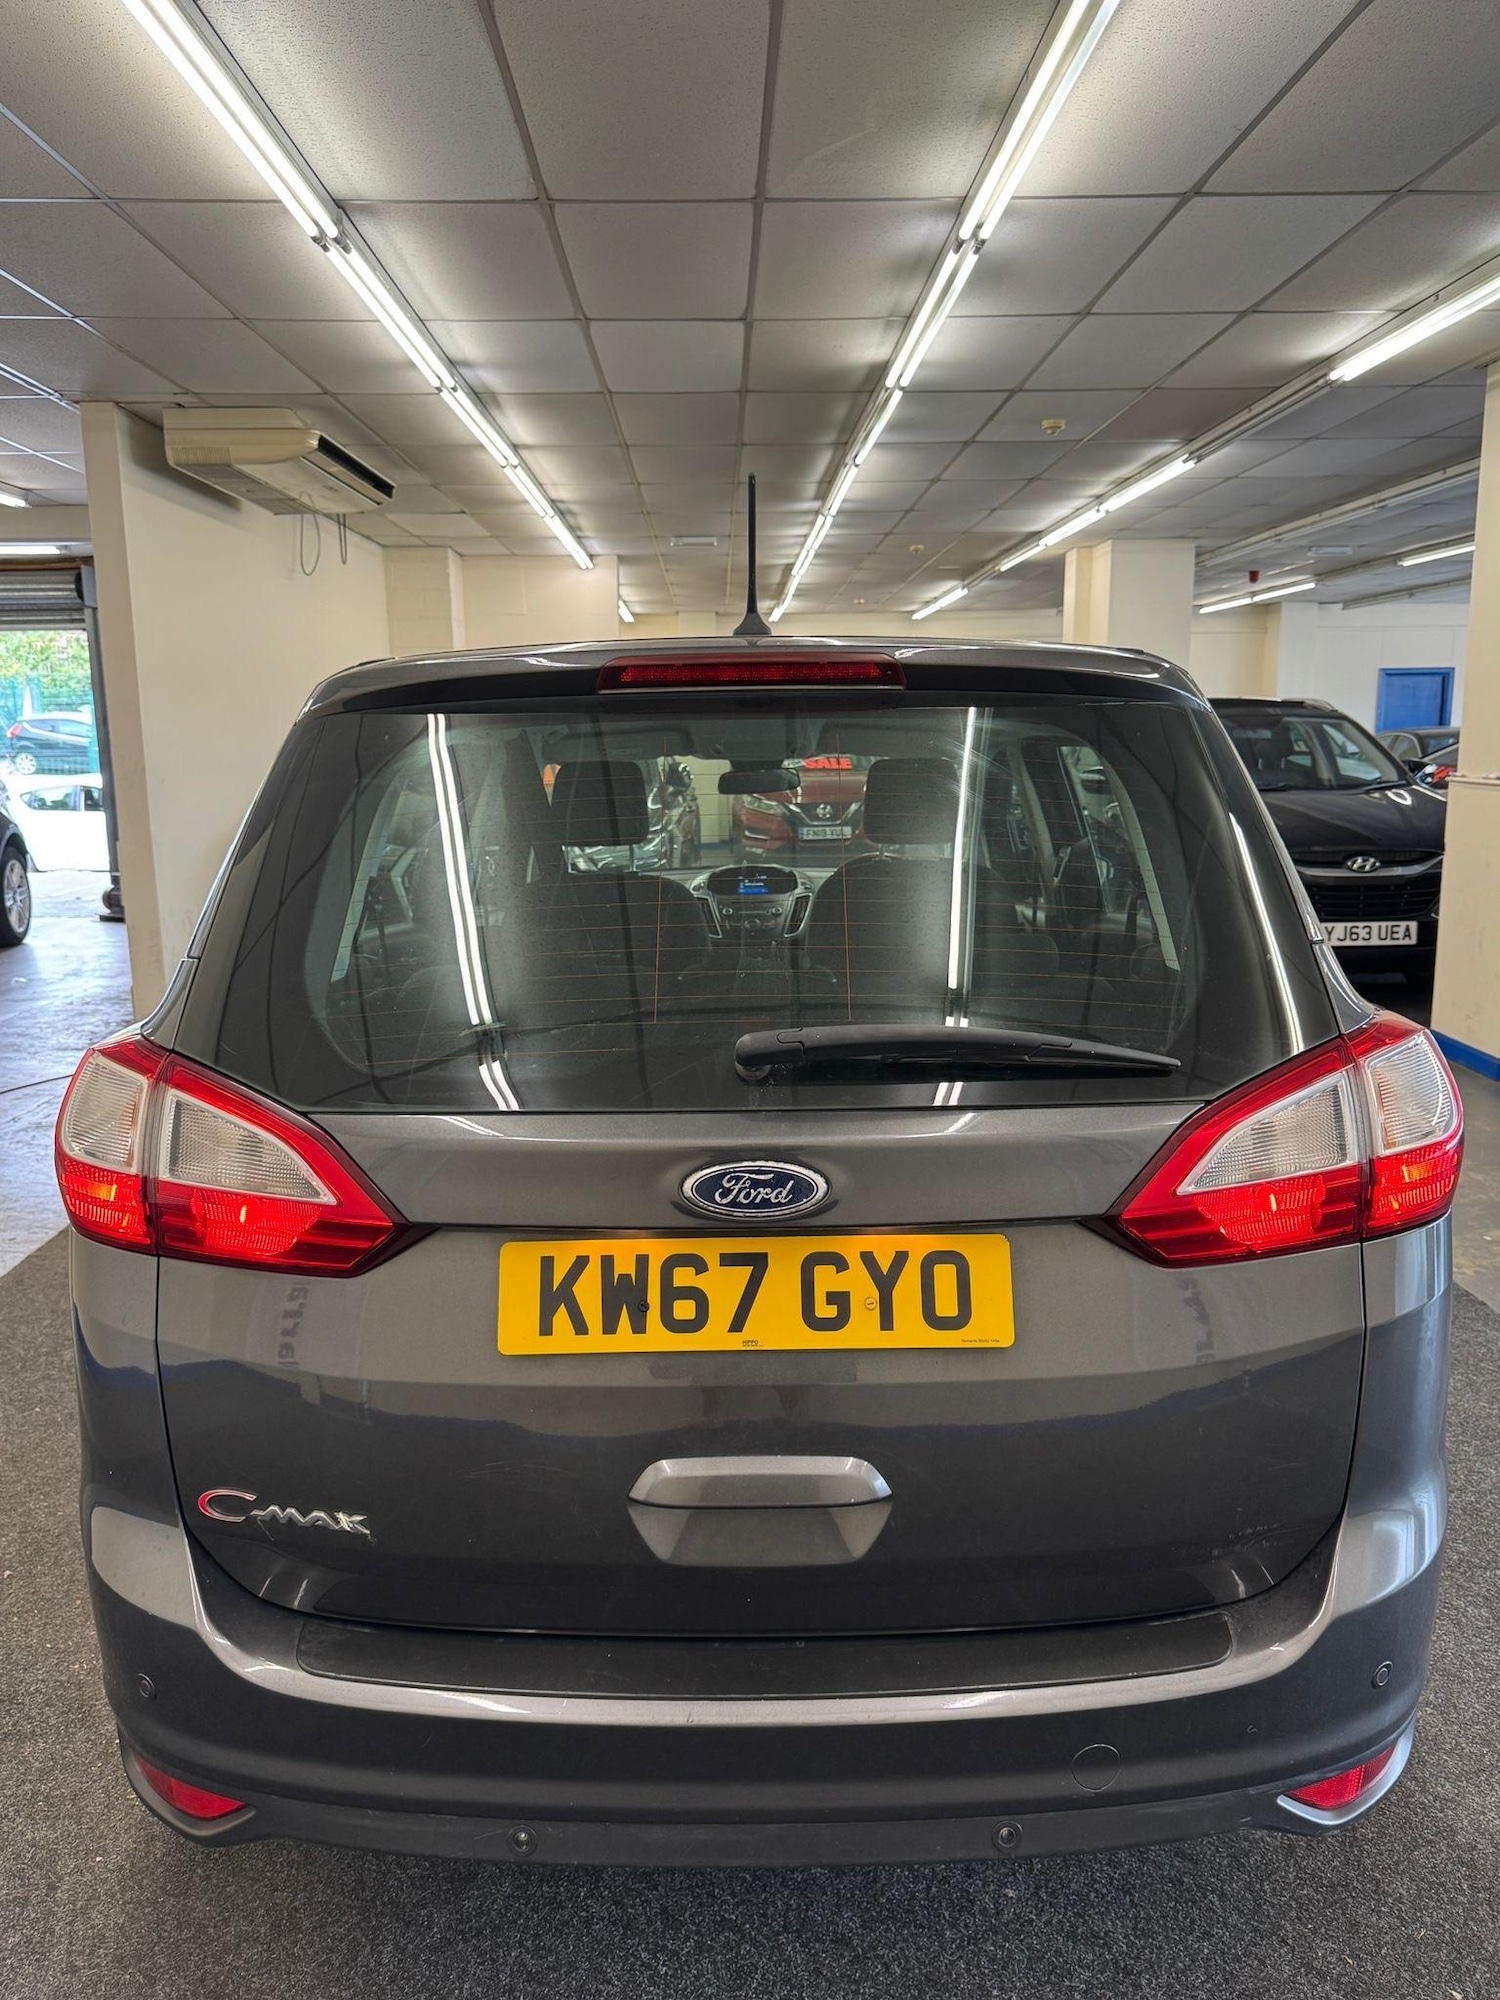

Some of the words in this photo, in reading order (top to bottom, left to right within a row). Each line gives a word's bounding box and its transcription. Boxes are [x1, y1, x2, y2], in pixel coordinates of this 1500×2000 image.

[803, 757, 853, 770] SALE
[1324, 925, 1372, 941] YJ63
[1378, 924, 1412, 940] UEA
[714, 1173, 794, 1204] Ford
[538, 1253, 769, 1336] KW67
[800, 1249, 972, 1332] GYO
